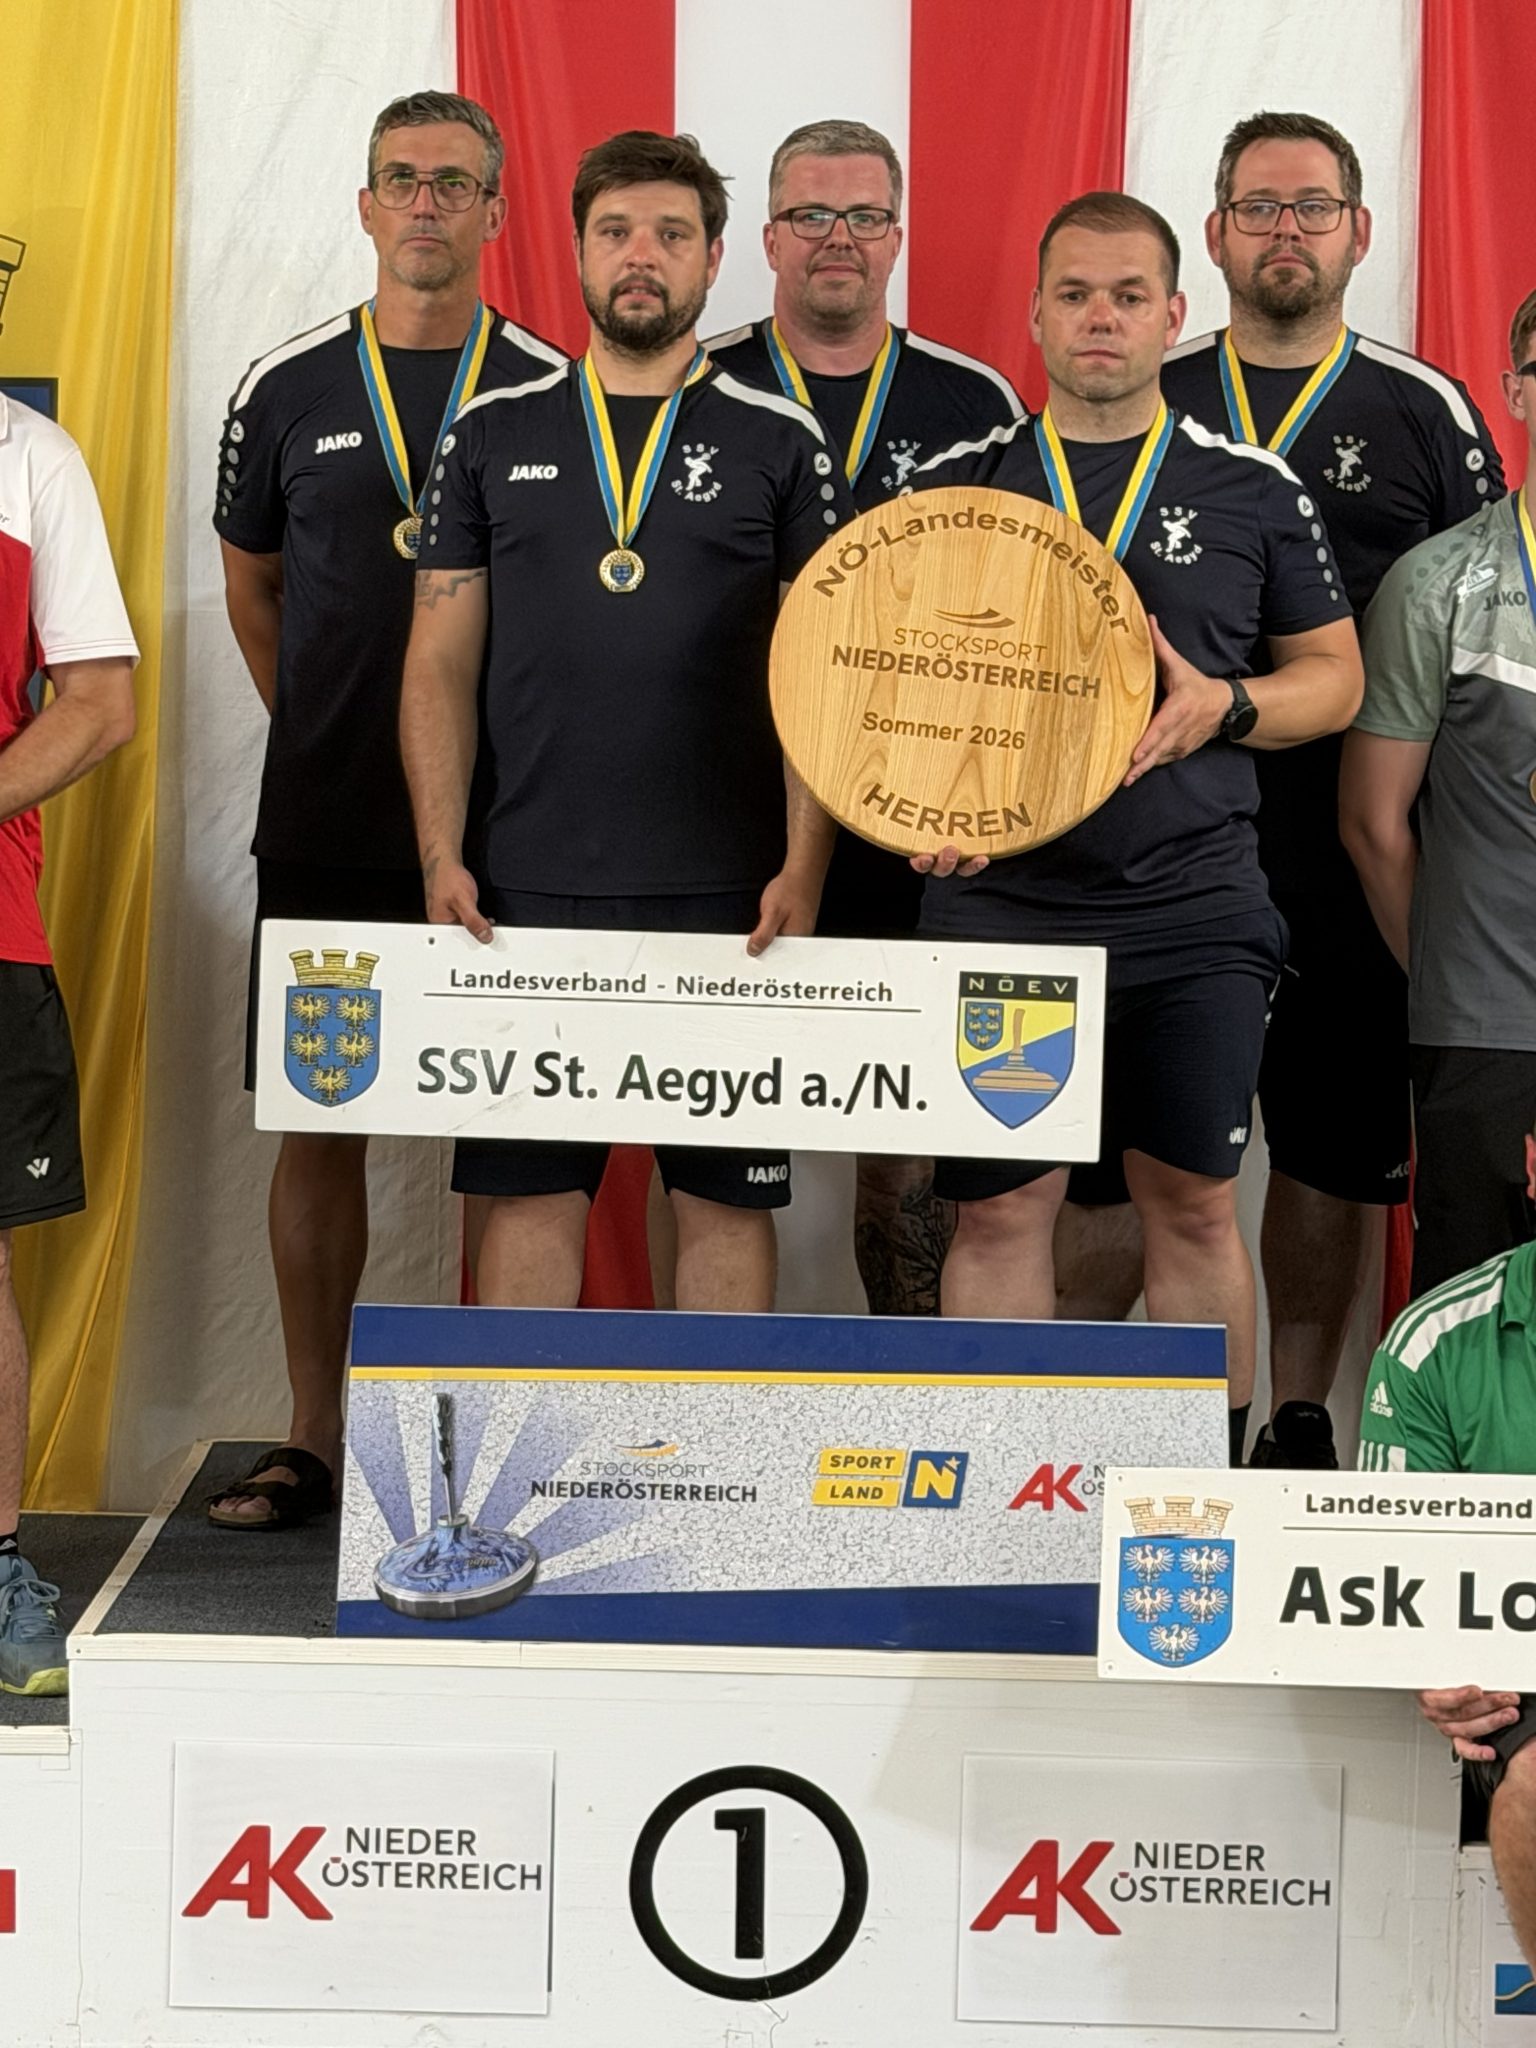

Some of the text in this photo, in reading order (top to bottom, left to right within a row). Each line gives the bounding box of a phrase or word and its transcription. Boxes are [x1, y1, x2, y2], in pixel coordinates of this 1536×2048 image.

[315, 431, 363, 455] JAKO
[508, 465, 558, 481] JAKO
[1160, 506, 1198, 520] SSV
[812, 506, 1130, 635] NÖ-Landesmeister
[1483, 591, 1527, 611] JAKO
[893, 627, 1048, 663] STOCKSPORT
[831, 645, 1101, 699] NIEDERÖSTERREICH
[862, 711, 1026, 750] Sommer 2026
[862, 782, 1033, 838] HERREN
[449, 968, 647, 995] Landesverband
[676, 975, 894, 1003] Niederösterreich
[968, 975, 1068, 995] NÖEV
[417, 1047, 929, 1118] SSV St. Aegyd a./N.
[747, 1164, 788, 1184] JAKO
[580, 1461, 710, 1478] STOCKSPORT
[830, 1455, 896, 1469] SPORT
[911, 1459, 957, 1499] N
[530, 1478, 757, 1502] NIEDERÖSTERREICH
[830, 1485, 884, 1499] LAND
[1007, 1464, 1088, 1512] AK
[1305, 1493, 1533, 1519] Landesverband
[1279, 1565, 1426, 1628] Ask
[345, 1826, 476, 1857] NIEDER
[1133, 1841, 1266, 1872] NIEDER
[181, 1825, 334, 1921] AK
[321, 1856, 542, 1892] ÖSTERREICH
[714, 1807, 766, 1960] 1
[969, 1839, 1122, 1936] AK
[1110, 1871, 1332, 1907] ÖSTERREICH
